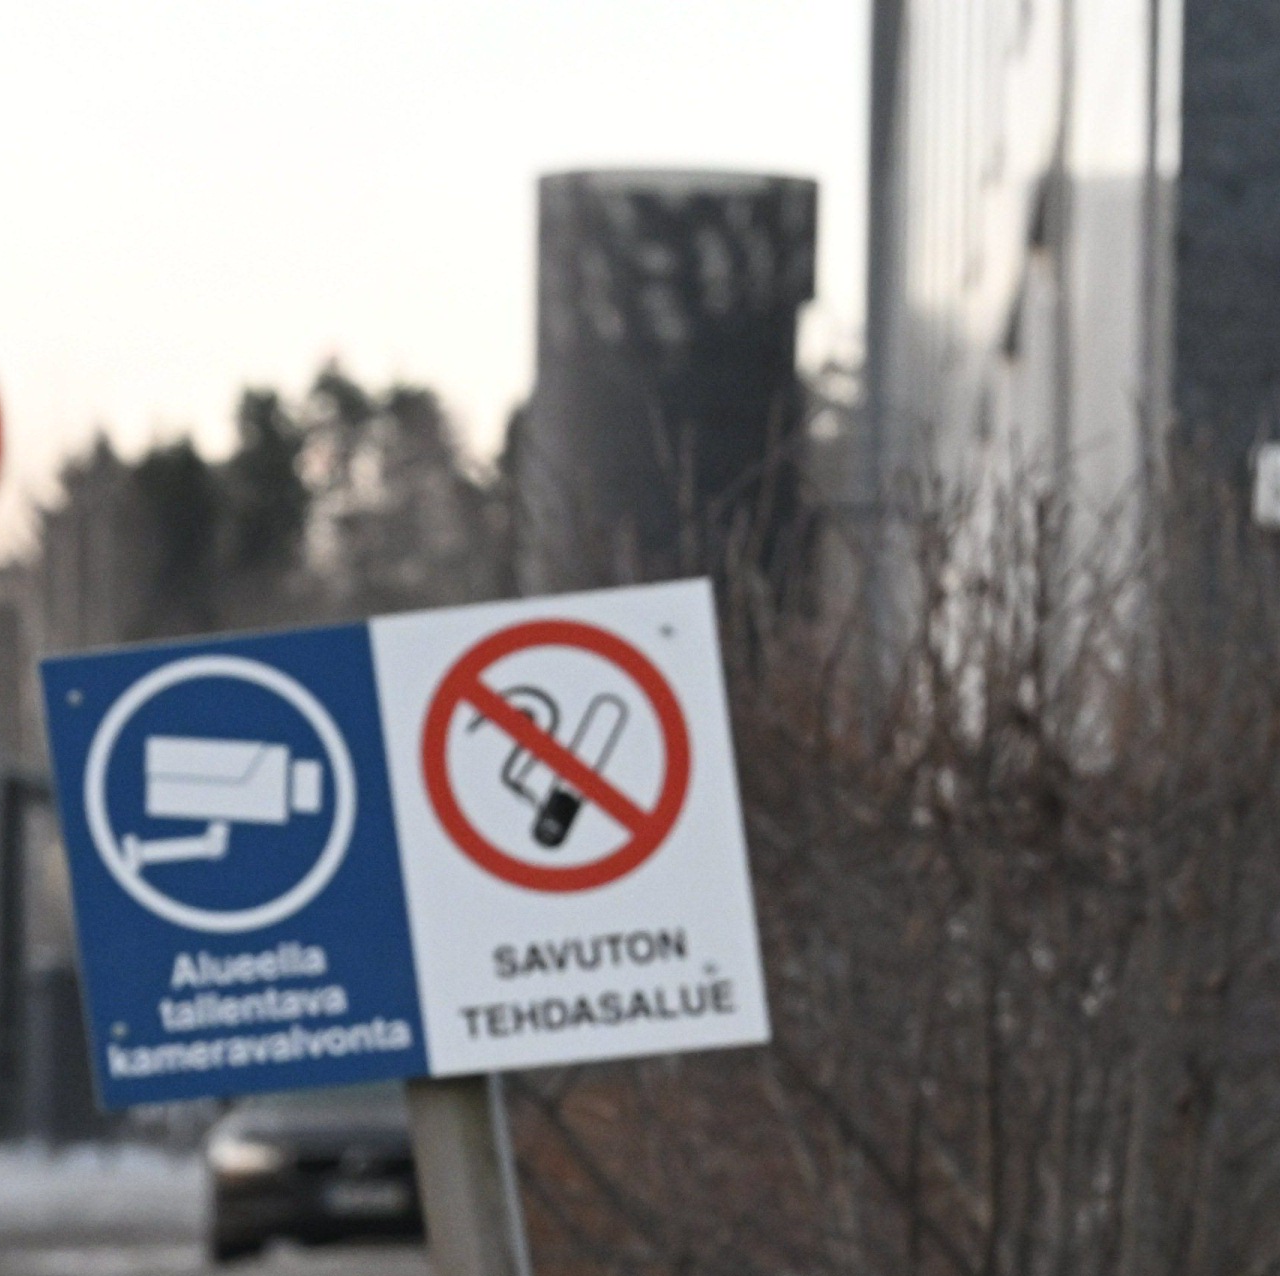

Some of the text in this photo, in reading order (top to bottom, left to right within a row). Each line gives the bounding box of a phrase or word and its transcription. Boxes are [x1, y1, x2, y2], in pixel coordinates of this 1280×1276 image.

[171, 941, 328, 991] Alueella
[492, 926, 688, 980] SAVUTON
[157, 984, 348, 1033] tallentava
[459, 978, 737, 1039] TEHDASALUE
[107, 1015, 414, 1080] kameravalvonta
